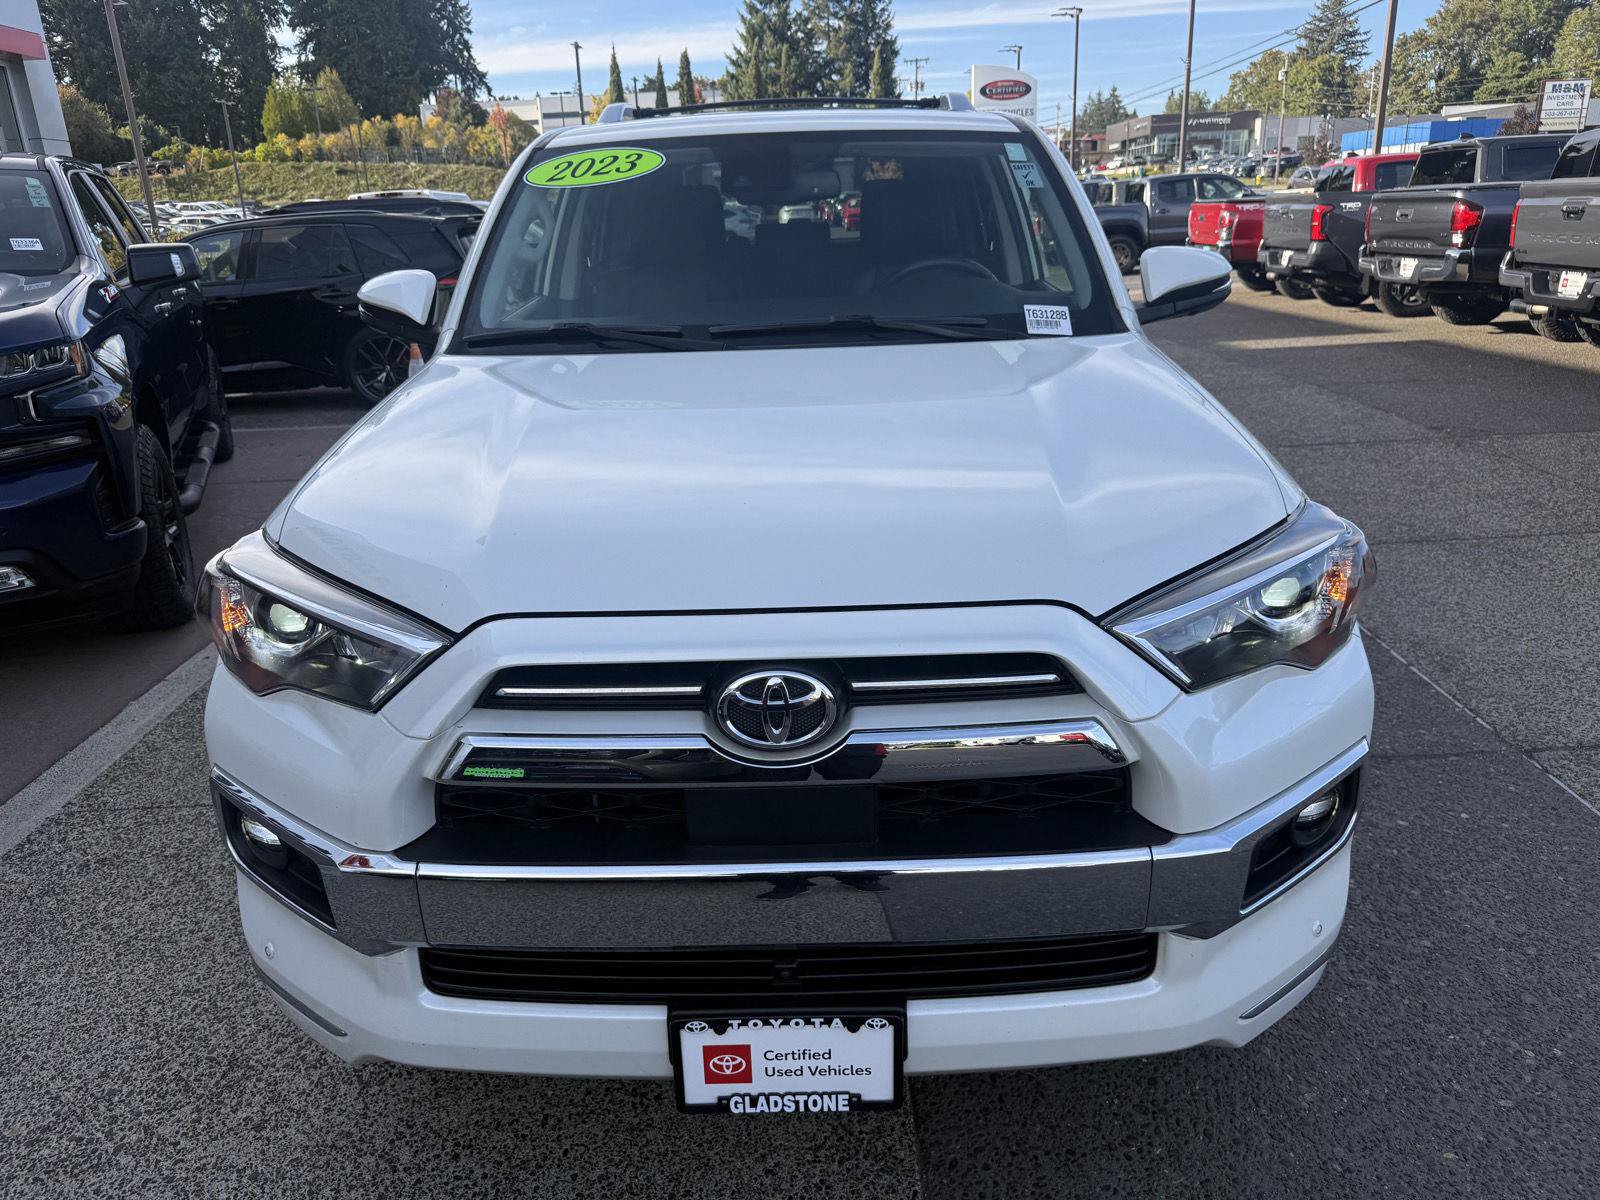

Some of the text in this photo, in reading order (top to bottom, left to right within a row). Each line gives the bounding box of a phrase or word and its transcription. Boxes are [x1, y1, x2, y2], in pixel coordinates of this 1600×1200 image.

[986, 86, 1025, 95] CERTIFIED
[1552, 83, 1584, 93] M&M
[545, 153, 643, 183] 2023
[1026, 309, 1068, 320] T63128B
[729, 1018, 845, 1030] TOYOTA
[763, 1049, 832, 1061] Certified
[764, 1064, 872, 1077] Used Vehicles
[730, 1094, 849, 1114] GLADSTONE
